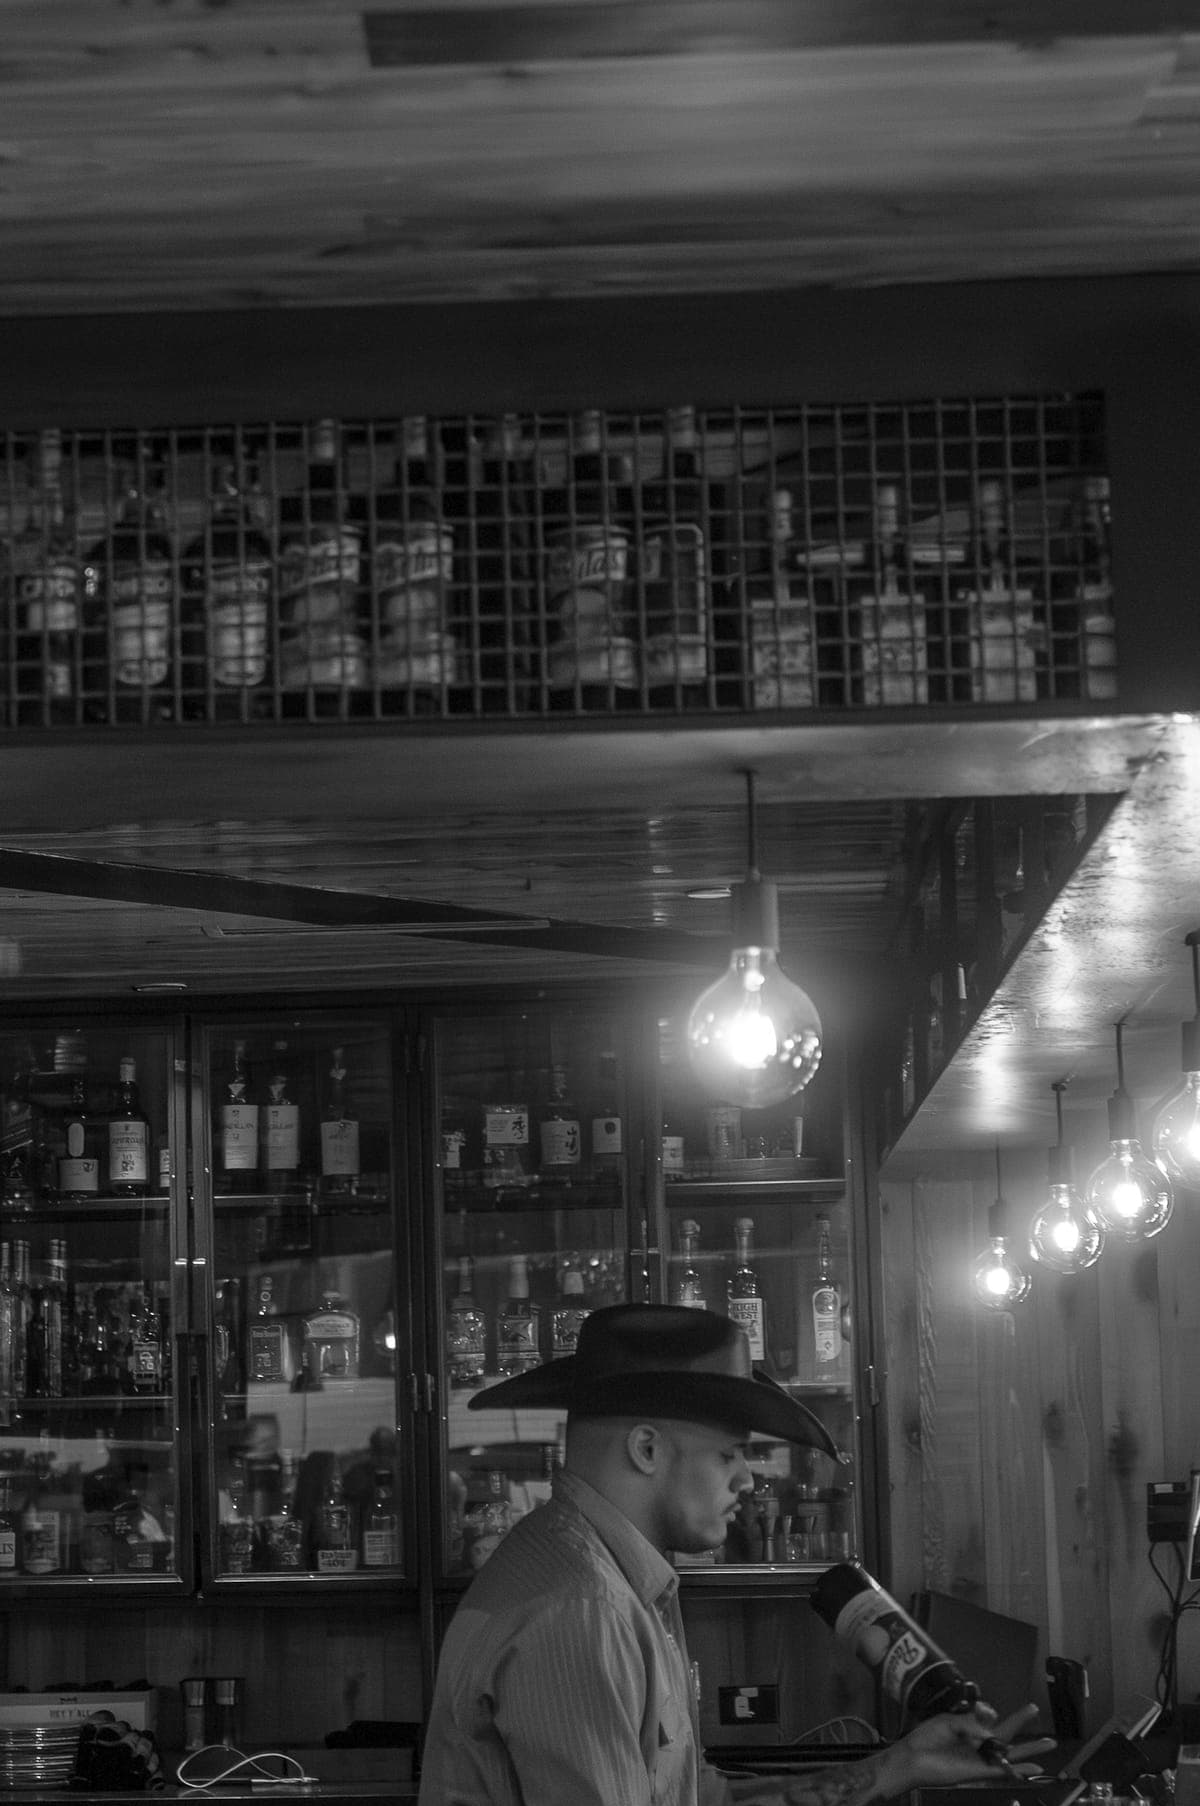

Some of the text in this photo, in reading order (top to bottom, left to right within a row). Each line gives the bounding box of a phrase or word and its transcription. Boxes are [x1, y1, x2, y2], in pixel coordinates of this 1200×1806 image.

[732, 1302, 759, 1311] HIGH
[732, 1311, 759, 1320] WEST
[49, 1709, 66, 1720] HEY
